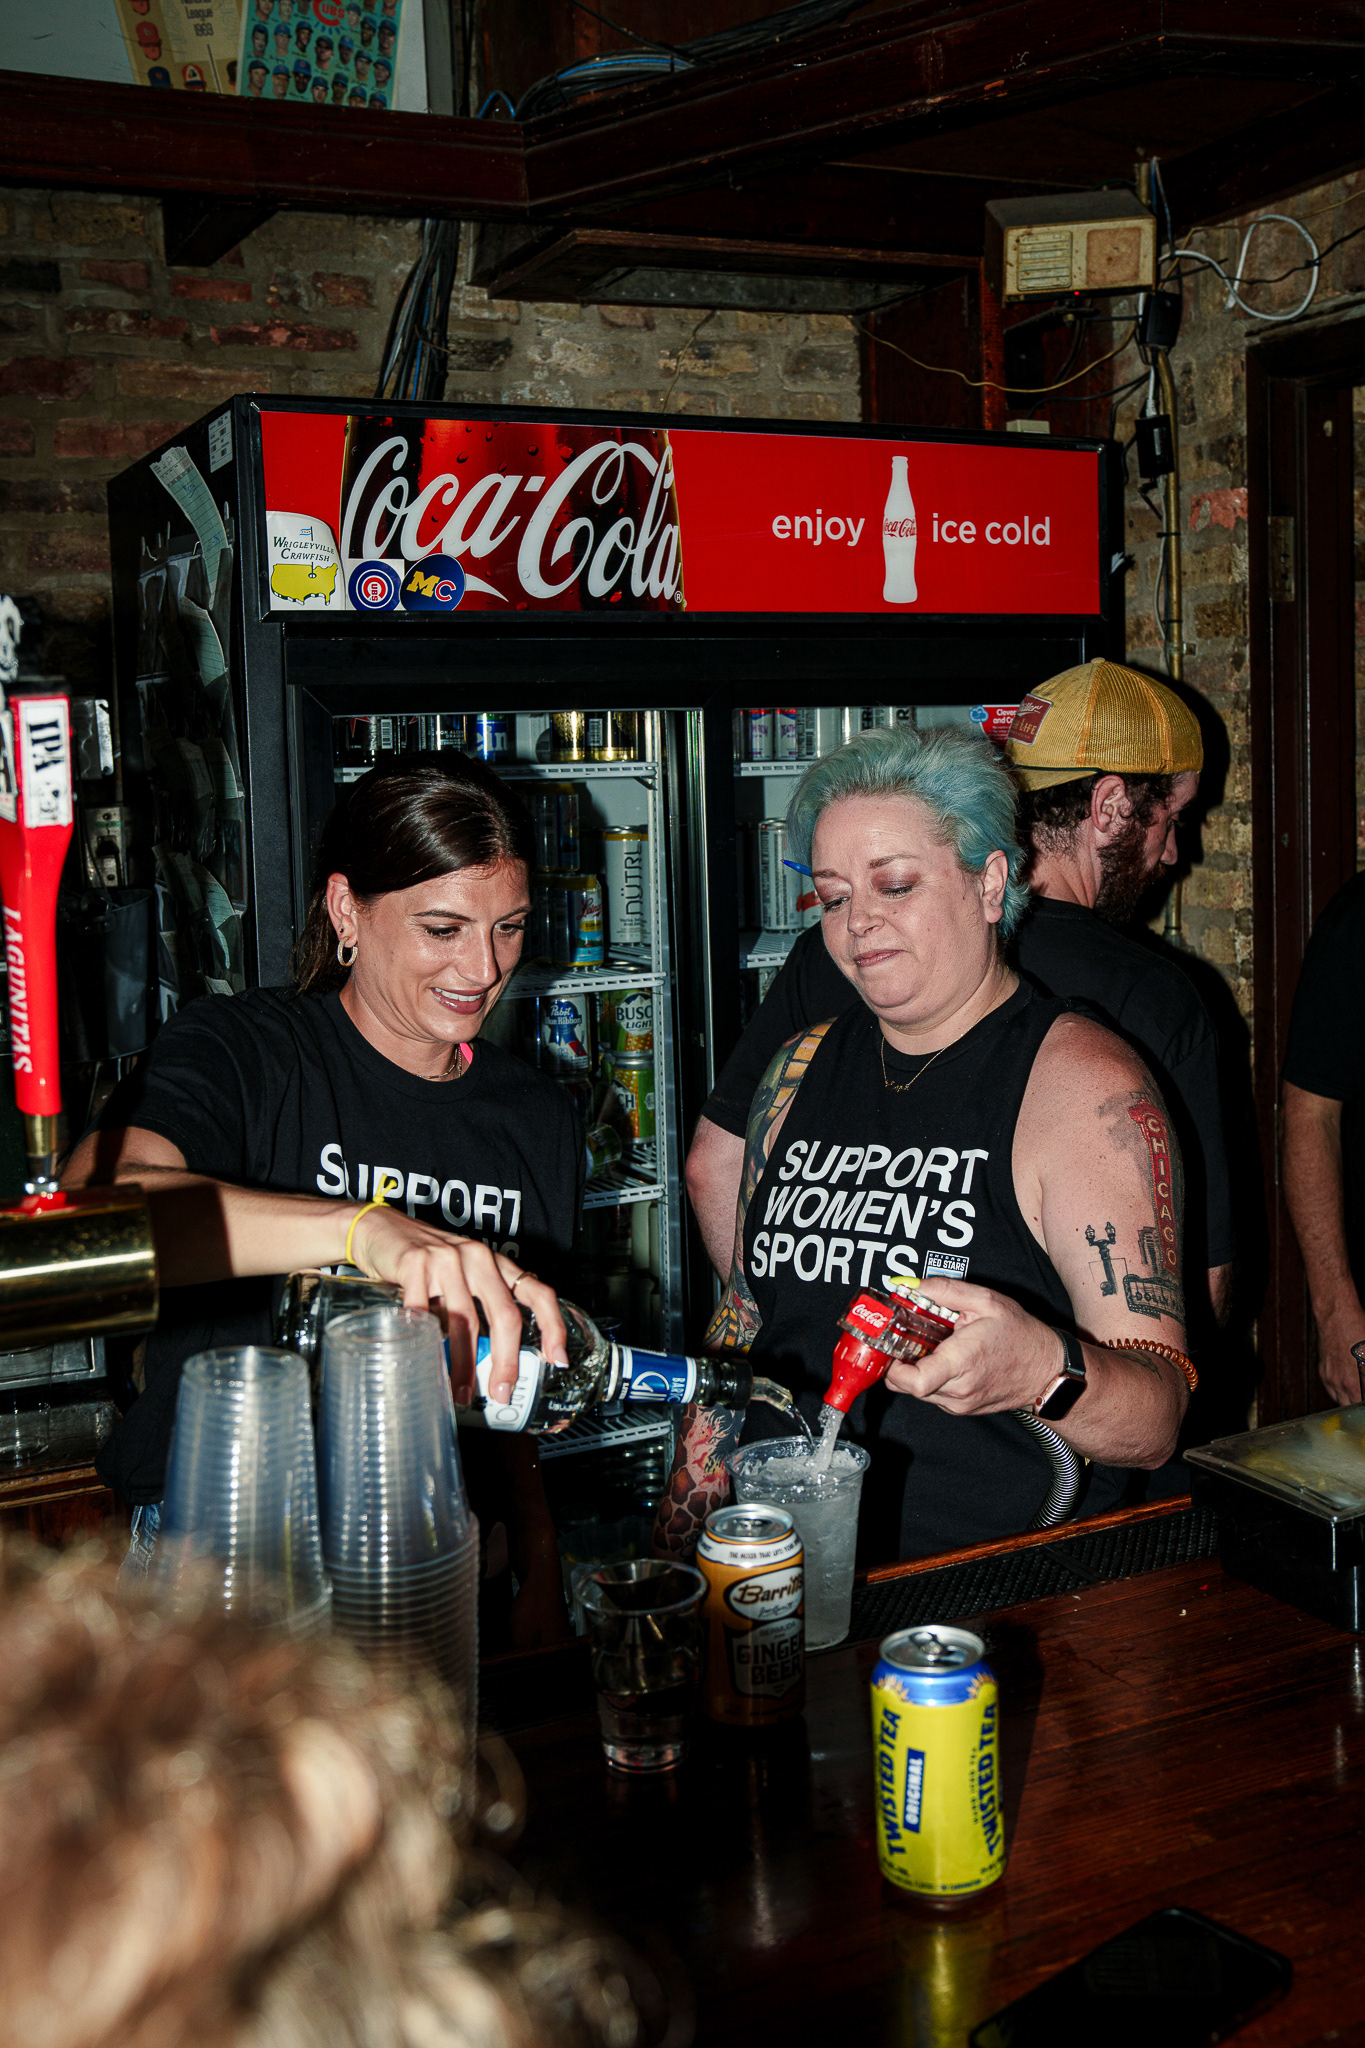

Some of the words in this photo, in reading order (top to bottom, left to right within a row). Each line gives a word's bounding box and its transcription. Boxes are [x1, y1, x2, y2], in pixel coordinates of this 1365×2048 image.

[184, 6, 213, 21] League
[340, 435, 682, 601] Coca-Cola
[772, 509, 866, 546] enjoy
[882, 518, 917, 538] Coca-Cola
[932, 512, 977, 544] ice
[985, 516, 1050, 546] cold
[273, 536, 335, 555] WRIGLEYVILLE
[281, 548, 330, 562] CRAWFISH
[1018, 718, 1038, 735] LIFE
[29, 720, 64, 773] IPA
[2, 906, 33, 1074] LAGUNITAS
[550, 1004, 572, 1016] Pabst
[557, 1016, 581, 1025] Ribbon
[616, 1006, 652, 1021] BUSC
[778, 1140, 989, 1194] SUPPORT
[316, 1143, 522, 1236] SUPPORT
[1146, 1112, 1177, 1266] CHICAGO
[763, 1186, 976, 1248] WOMEN'S
[751, 1231, 919, 1293] SPORTS
[928, 1257, 942, 1267] RED
[943, 1259, 966, 1272] STARS
[851, 1303, 889, 1329] Coca-Cola
[666, 1377, 686, 1404] BARTO
[752, 1656, 802, 1685] BEER
[879, 1706, 901, 1750] TEA
[978, 1702, 997, 1750] TEA
[879, 1751, 906, 1856] TWISTED
[905, 1758, 923, 1825] ORIGINAL
[978, 1753, 1001, 1856] TWISTED
